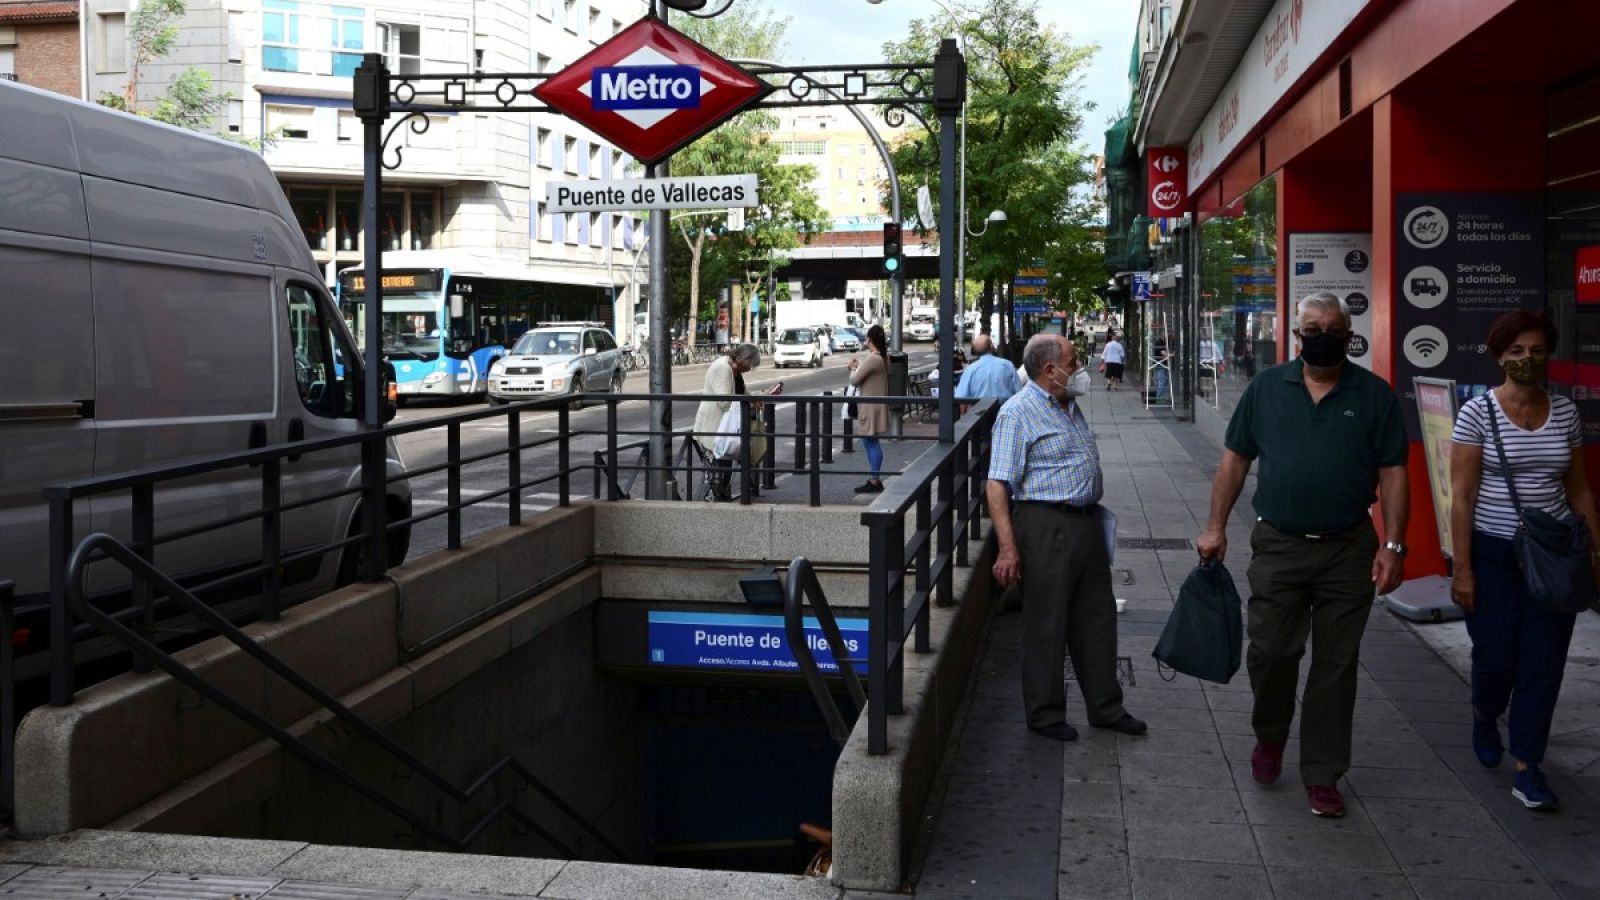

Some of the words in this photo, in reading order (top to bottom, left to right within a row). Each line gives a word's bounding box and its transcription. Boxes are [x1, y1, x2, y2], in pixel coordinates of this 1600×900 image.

[600, 73, 692, 101] Metro
[558, 186, 625, 206] Puente
[631, 184, 655, 204] de
[661, 182, 745, 202] Vallecas
[1157, 191, 1178, 201] 24/7
[1417, 222, 1438, 231] 24/7
[1456, 221, 1471, 230] 24
[1473, 220, 1504, 230] horas
[1457, 232, 1488, 241] todos
[1490, 231, 1506, 241] los
[1352, 252, 1361, 261] 3
[1456, 263, 1501, 272] Servicio
[1456, 276, 1464, 284] a
[1465, 274, 1516, 284] domicilio
[694, 630, 754, 647] Puente
[759, 633, 781, 649] de
